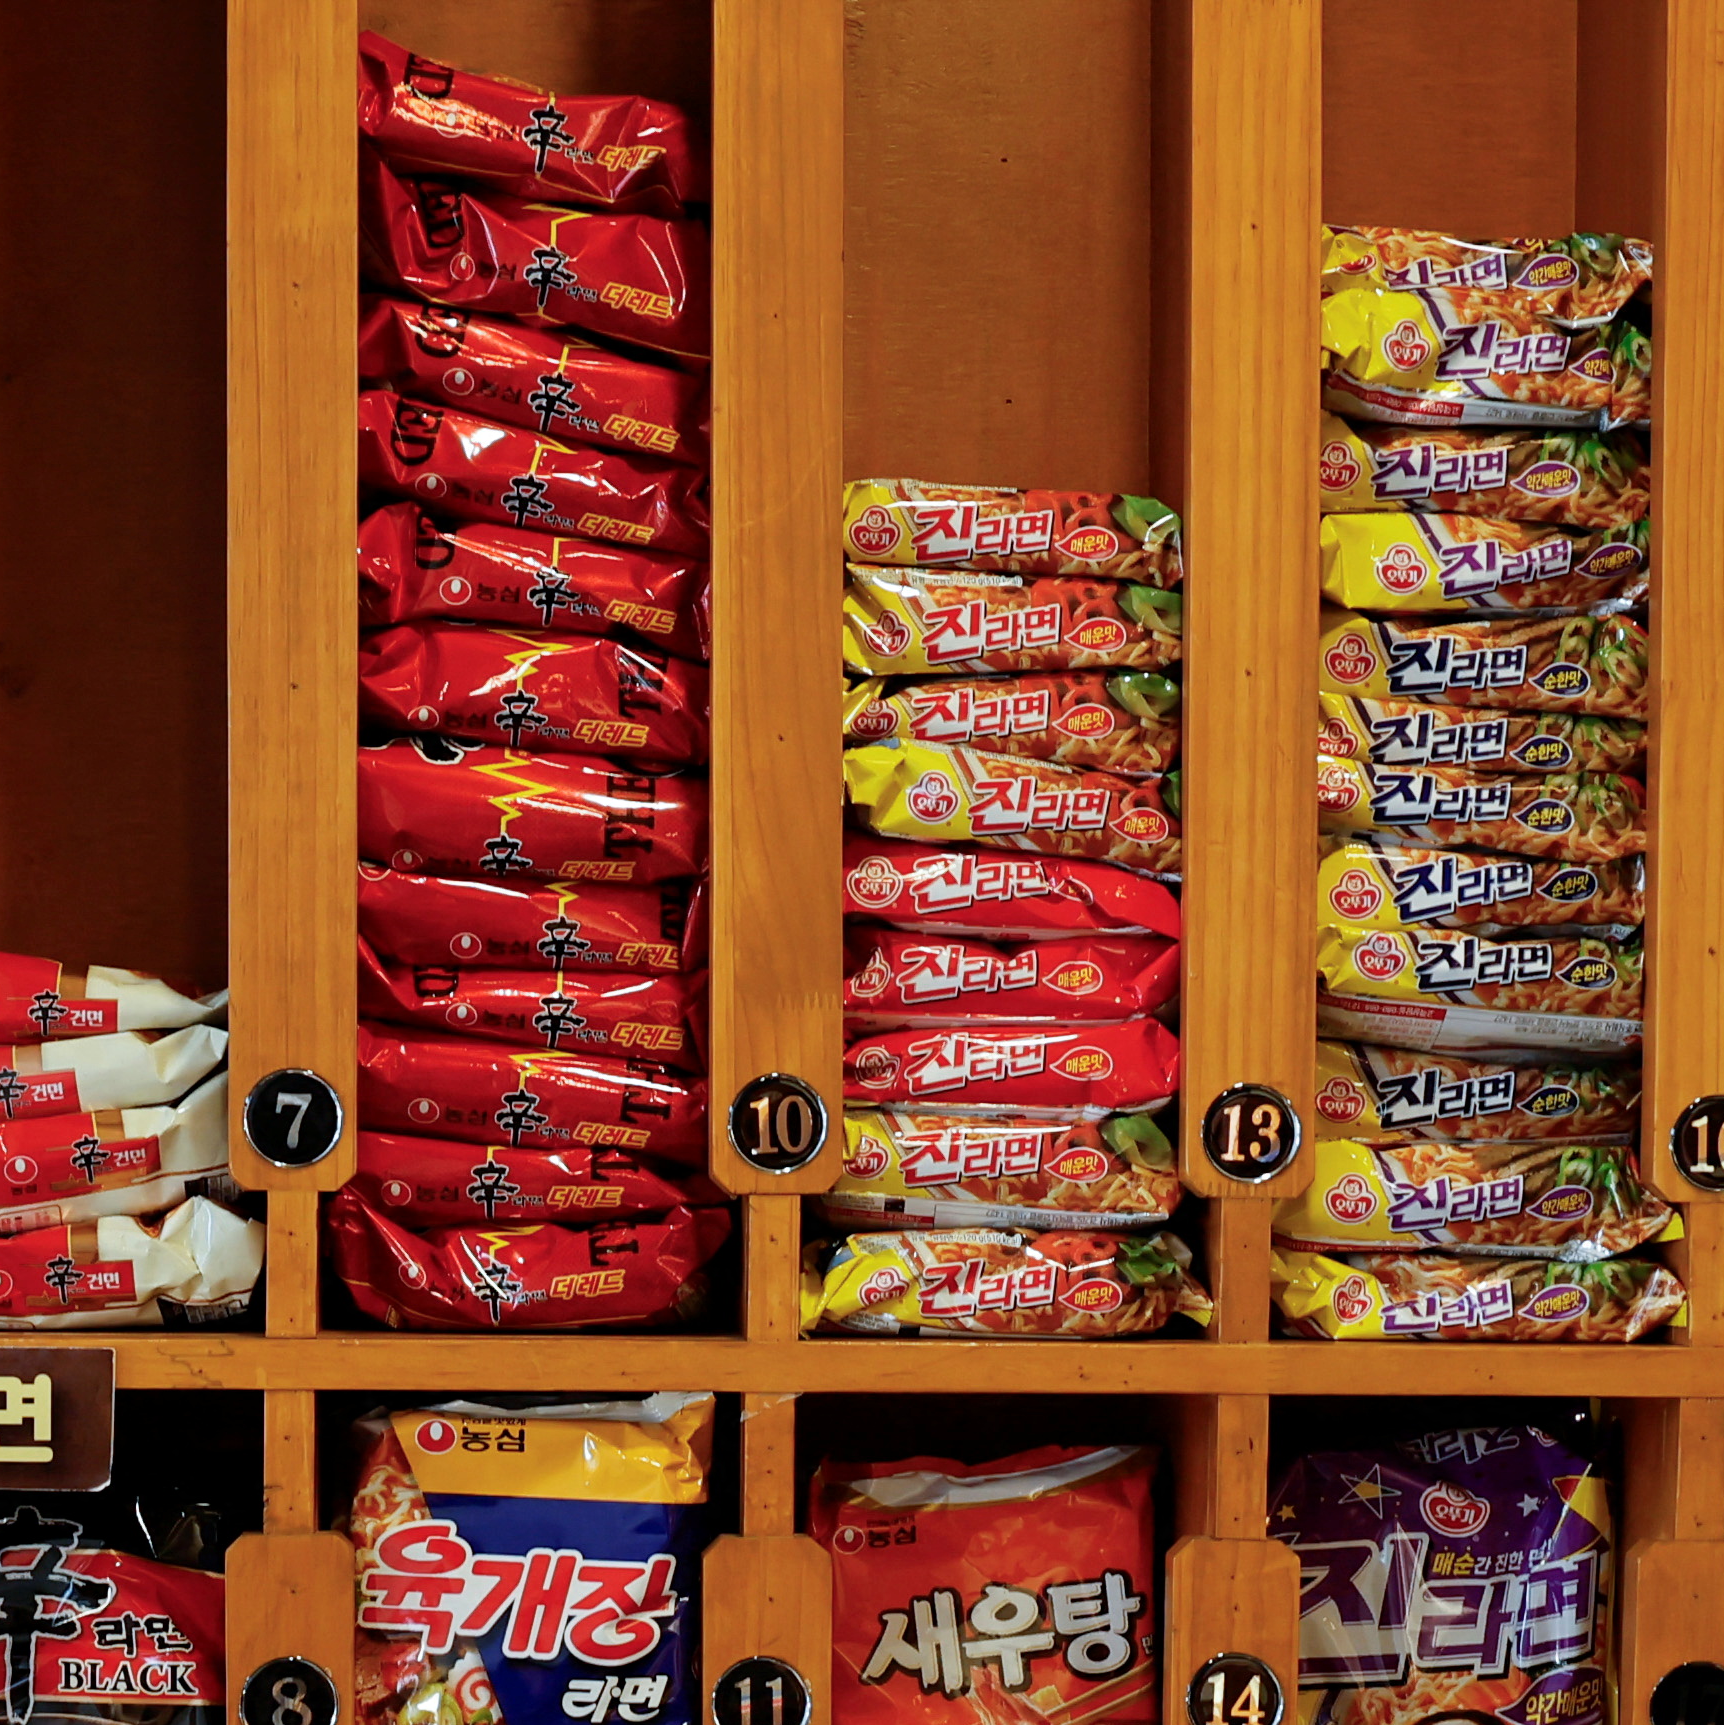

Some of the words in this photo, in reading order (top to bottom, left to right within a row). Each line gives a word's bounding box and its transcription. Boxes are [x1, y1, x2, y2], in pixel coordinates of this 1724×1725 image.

[1434, 321, 1571, 381] 진라면
[603, 413, 680, 453] 더레드
[1526, 469, 1573, 491] 약간매운맛
[577, 512, 655, 545] 더레드
[912, 505, 1054, 562] 진라면
[1070, 534, 1109, 554] 매운맛
[604, 599, 677, 634] 더레드
[922, 601, 1062, 665] 진라면
[1079, 623, 1118, 645] 매운맛
[1542, 670, 1582, 691] 순한맛
[573, 718, 649, 747] 더레드
[968, 777, 1111, 836] 진라면
[1123, 816, 1161, 835] 매운맛
[1551, 874, 1590, 897] 순한맛
[897, 945, 1038, 1004] 진라면
[1057, 966, 1094, 988] 매운맛
[69, 1009, 104, 1028] 건면
[275, 1092, 313, 1148] 7
[749, 1096, 811, 1156] 10
[1222, 1103, 1282, 1162] 13
[113, 1148, 147, 1167] 건면
[917, 1260, 1060, 1319] 진라면
[1074, 1286, 1114, 1307] 매운맛
[459, 1426, 527, 1454] 농심
[1432, 1552, 1492, 1576] 매순간
[1495, 1551, 1523, 1572] 진한
[357, 1520, 677, 1667] 육개장
[860, 1571, 1142, 1695] 새우탕
[58, 1659, 199, 1696] BLACK
[562, 1675, 669, 1725] 라면
